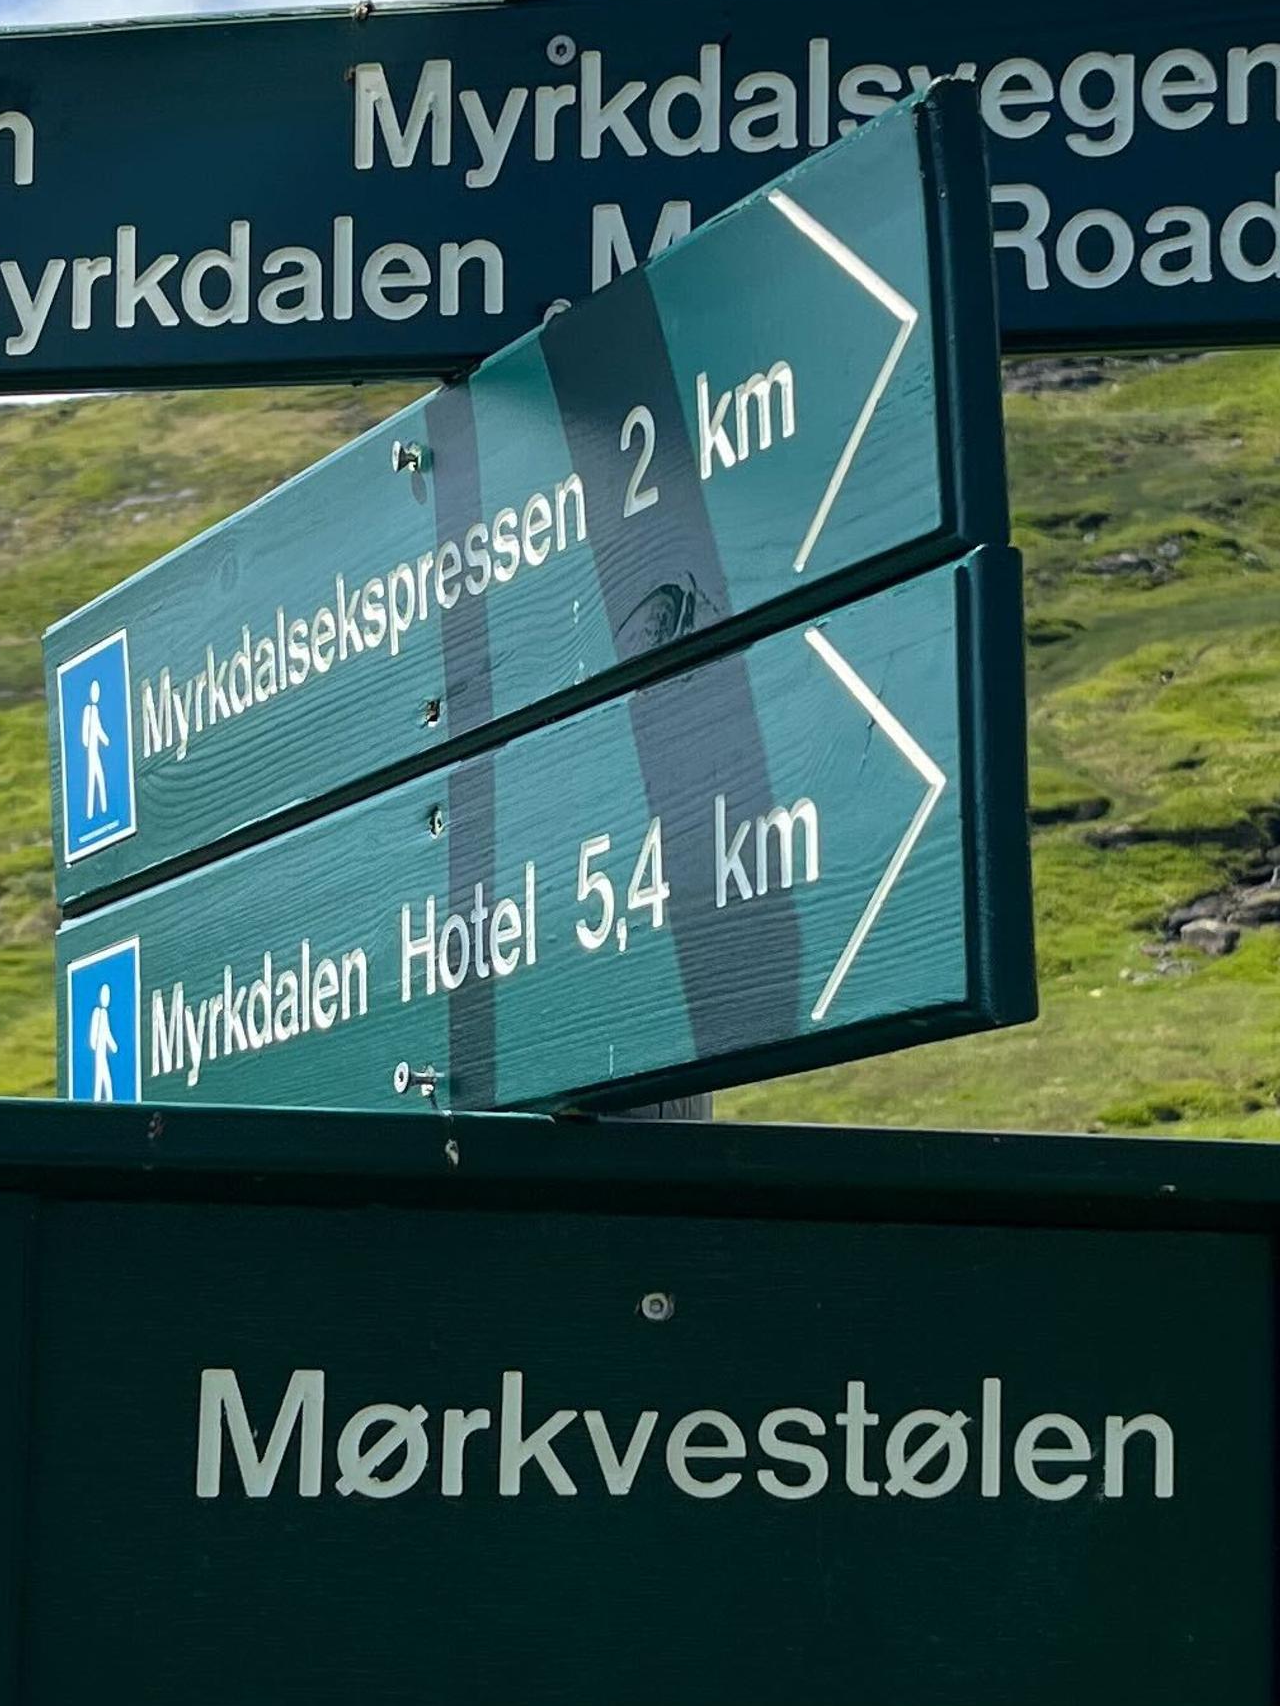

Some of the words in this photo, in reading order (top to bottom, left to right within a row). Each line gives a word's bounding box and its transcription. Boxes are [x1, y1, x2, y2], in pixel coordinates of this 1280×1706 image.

[142, 469, 587, 760] Myrkdalsekspressen
[619, 404, 660, 519] 2
[697, 359, 796, 481] km
[150, 936, 368, 1088] Myrkdalen
[399, 860, 538, 1003] Hotel
[576, 815, 671, 953] 5,4
[714, 793, 821, 909] km
[195, 1367, 1176, 1501] Mørkvestølen
